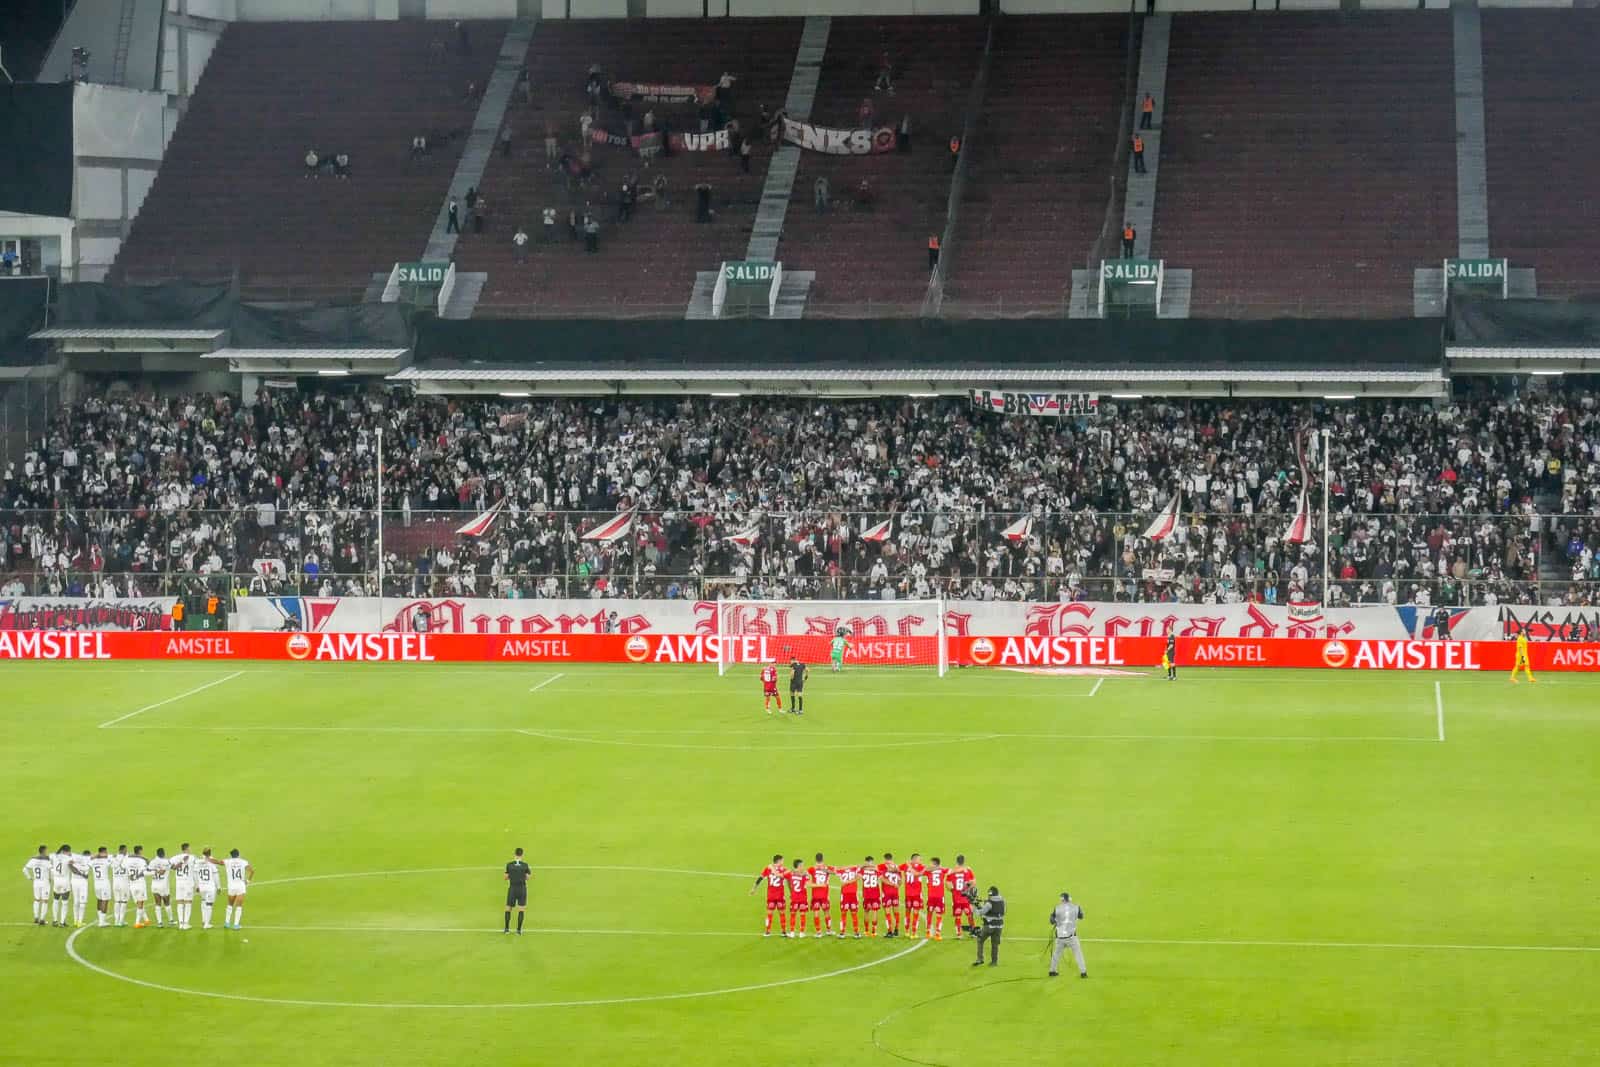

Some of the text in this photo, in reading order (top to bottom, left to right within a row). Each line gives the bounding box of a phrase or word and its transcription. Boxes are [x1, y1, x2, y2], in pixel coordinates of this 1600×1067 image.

[1104, 265, 1158, 278] SALIDA
[1447, 264, 1503, 277] SALIDA
[969, 389, 1098, 415] LA BRUTAL
[166, 638, 233, 654] AMSTEL
[315, 634, 435, 660] AMSTEL
[502, 640, 570, 656] AMSTEL
[654, 635, 776, 662] AMSTEL
[846, 642, 916, 658] AMSTEL
[1000, 638, 1124, 664] AMSTEL
[1194, 645, 1266, 661] AMSTEL
[1353, 641, 1481, 669] AMSTEL
[95, 866, 101, 878] 5
[932, 874, 940, 886] 5
[793, 880, 801, 892] 2
